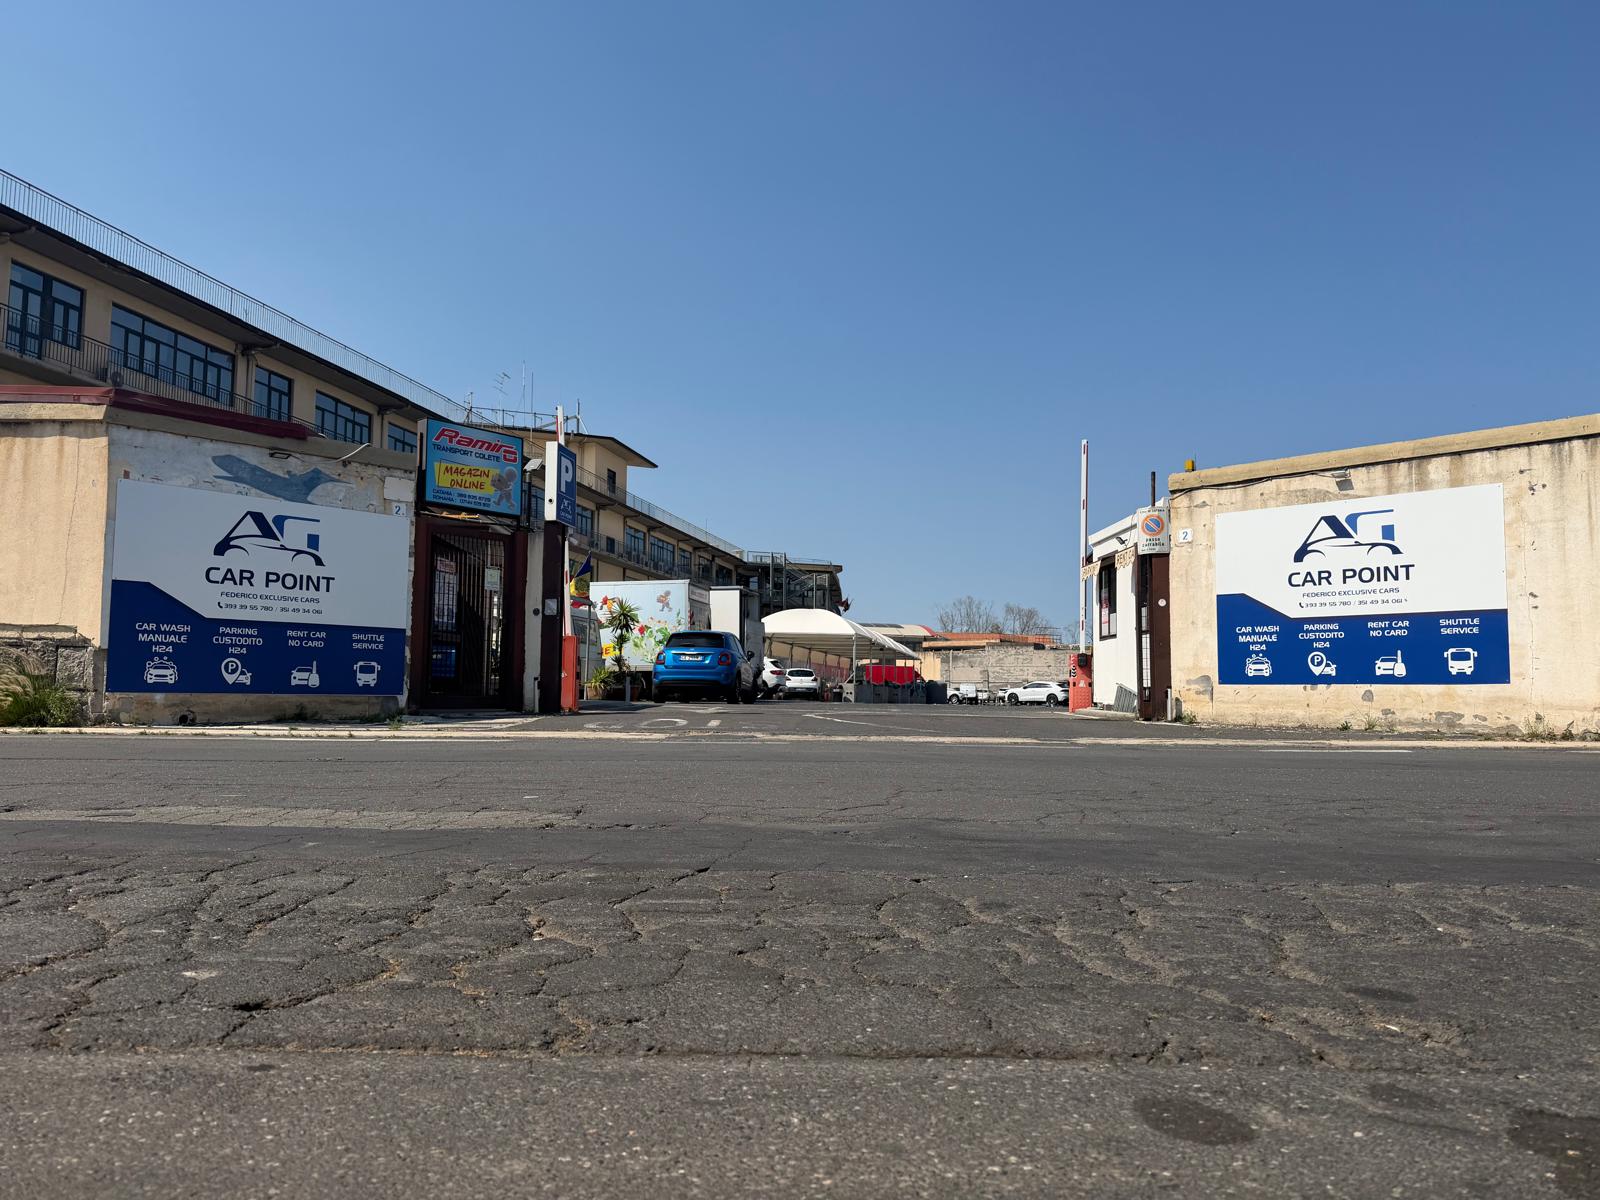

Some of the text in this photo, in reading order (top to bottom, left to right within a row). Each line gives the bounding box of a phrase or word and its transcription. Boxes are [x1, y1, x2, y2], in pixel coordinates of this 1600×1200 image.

[432, 426, 518, 464] Ramiro
[432, 443, 501, 462] TRANSPORT COLETE
[443, 465, 490, 478] MAGAZIN
[560, 456, 573, 493] P
[450, 479, 486, 490] ONLINE
[1182, 531, 1188, 540] 2
[205, 567, 335, 592] CAR POINT
[1288, 564, 1415, 587] CAR POINT
[221, 591, 258, 600] FEDERICO
[260, 594, 299, 602] EXCLUSIVE
[1440, 618, 1480, 626] SHUTTLE
[136, 622, 191, 632] CAR WASH
[220, 627, 258, 635] PARKING
[1254, 625, 1280, 633] WASH
[1441, 627, 1479, 635] SERVICE
[138, 633, 187, 643] MANUALE
[287, 630, 308, 638] RENT
[352, 633, 385, 642] SHUTTLE
[1239, 634, 1277, 642] MANUALE
[213, 636, 262, 645] CUSTODITO
[303, 640, 324, 648] CARD
[152, 645, 173, 653] H24
[352, 642, 384, 650] SERVICE
